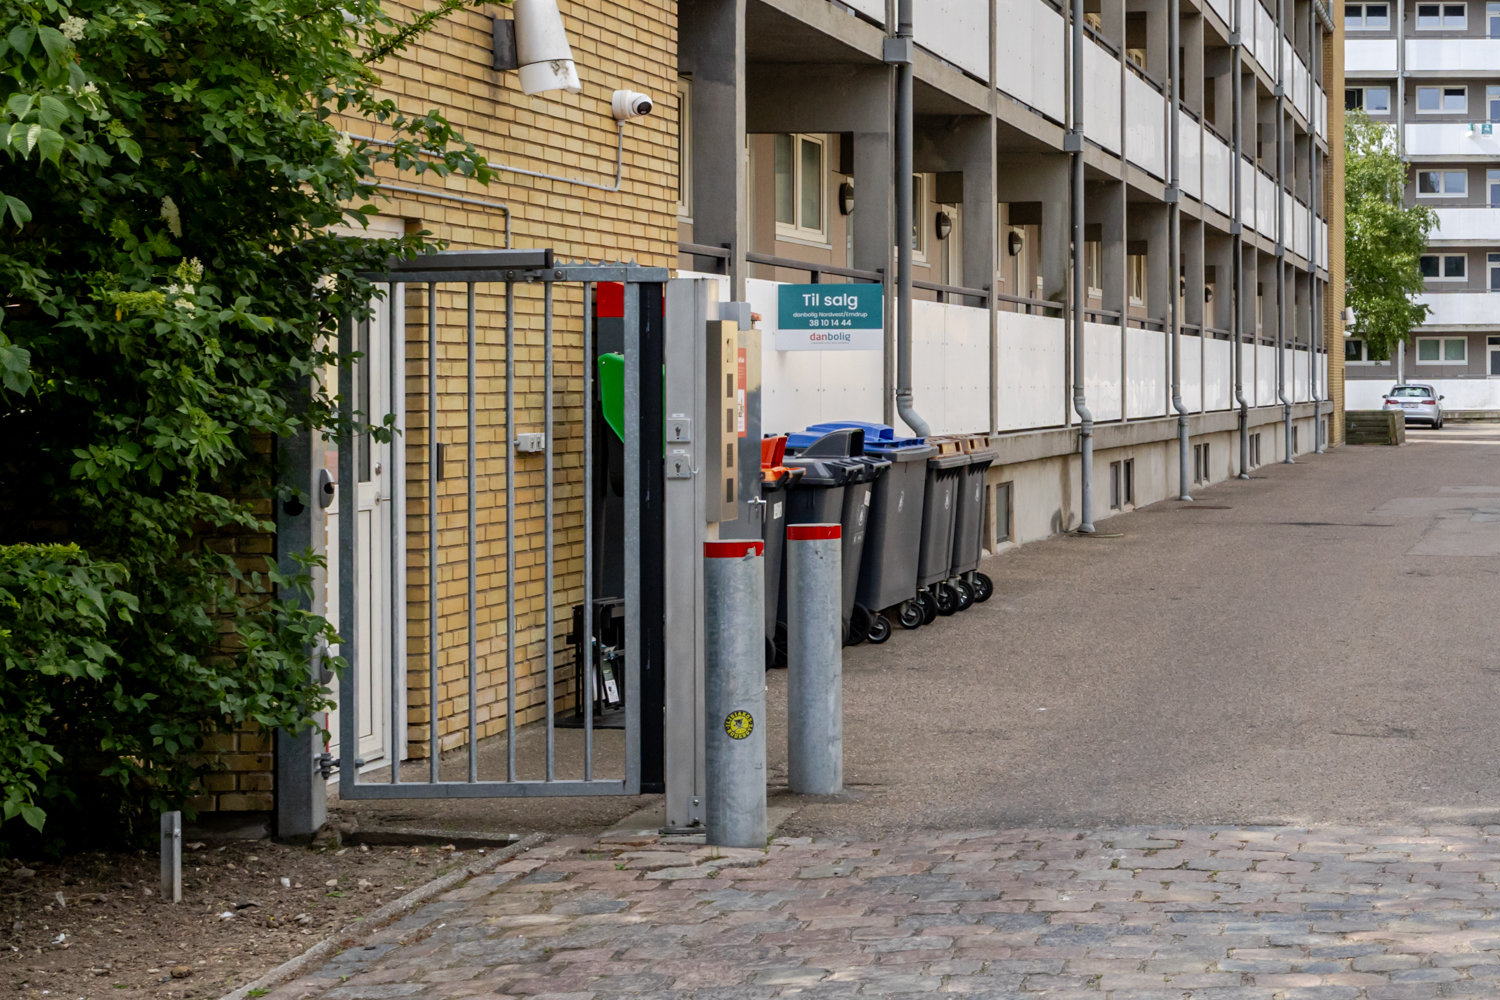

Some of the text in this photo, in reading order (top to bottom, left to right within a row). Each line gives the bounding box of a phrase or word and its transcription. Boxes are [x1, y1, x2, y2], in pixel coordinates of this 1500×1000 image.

[802, 293, 858, 310] Til salg
[809, 319, 852, 327] 38 10 14 44
[810, 332, 851, 342] danbolig
